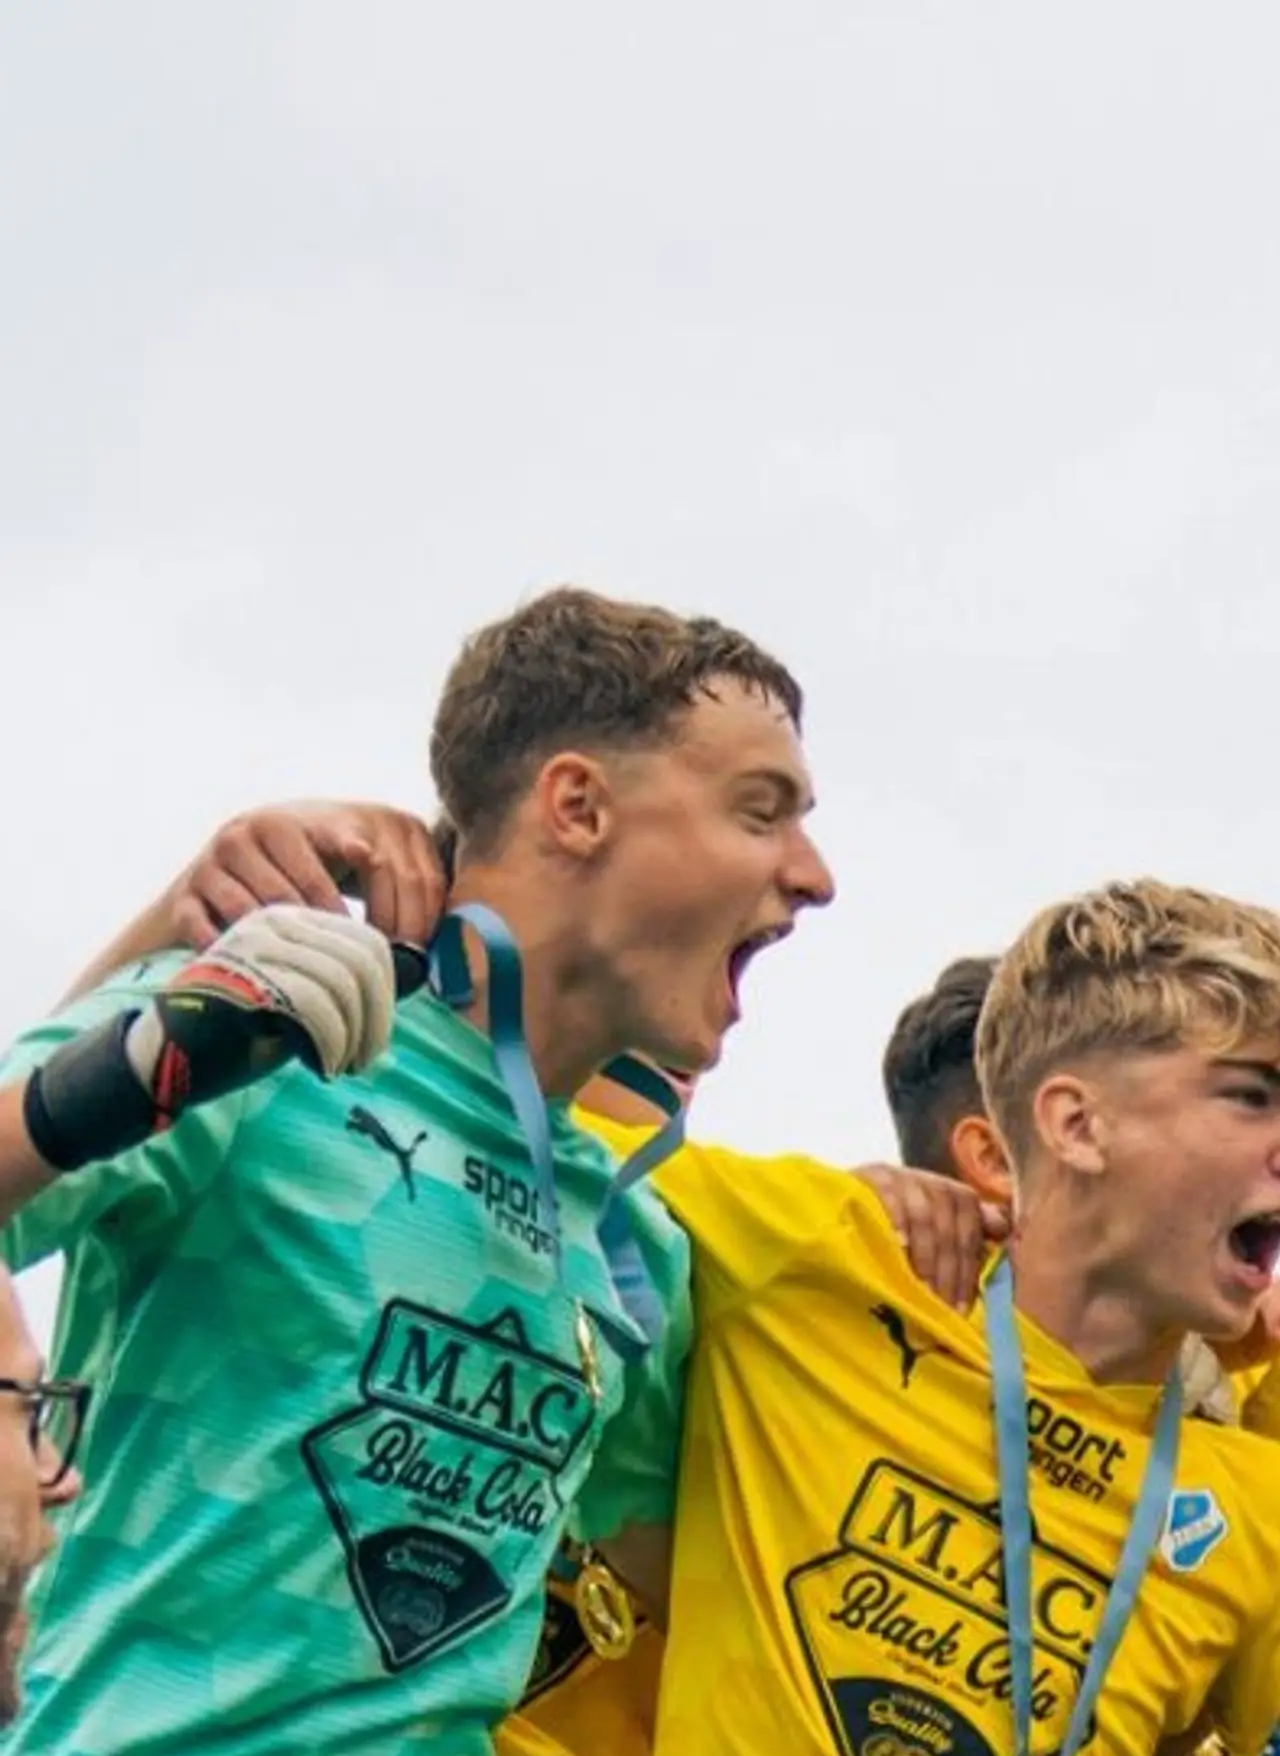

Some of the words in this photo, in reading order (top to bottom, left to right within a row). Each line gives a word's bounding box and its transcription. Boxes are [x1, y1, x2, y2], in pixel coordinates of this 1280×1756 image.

[386, 1325, 580, 1448] M.A.C
[356, 1419, 474, 1505] Black
[1025, 1397, 1126, 1484] port
[828, 1569, 964, 1668] Black
